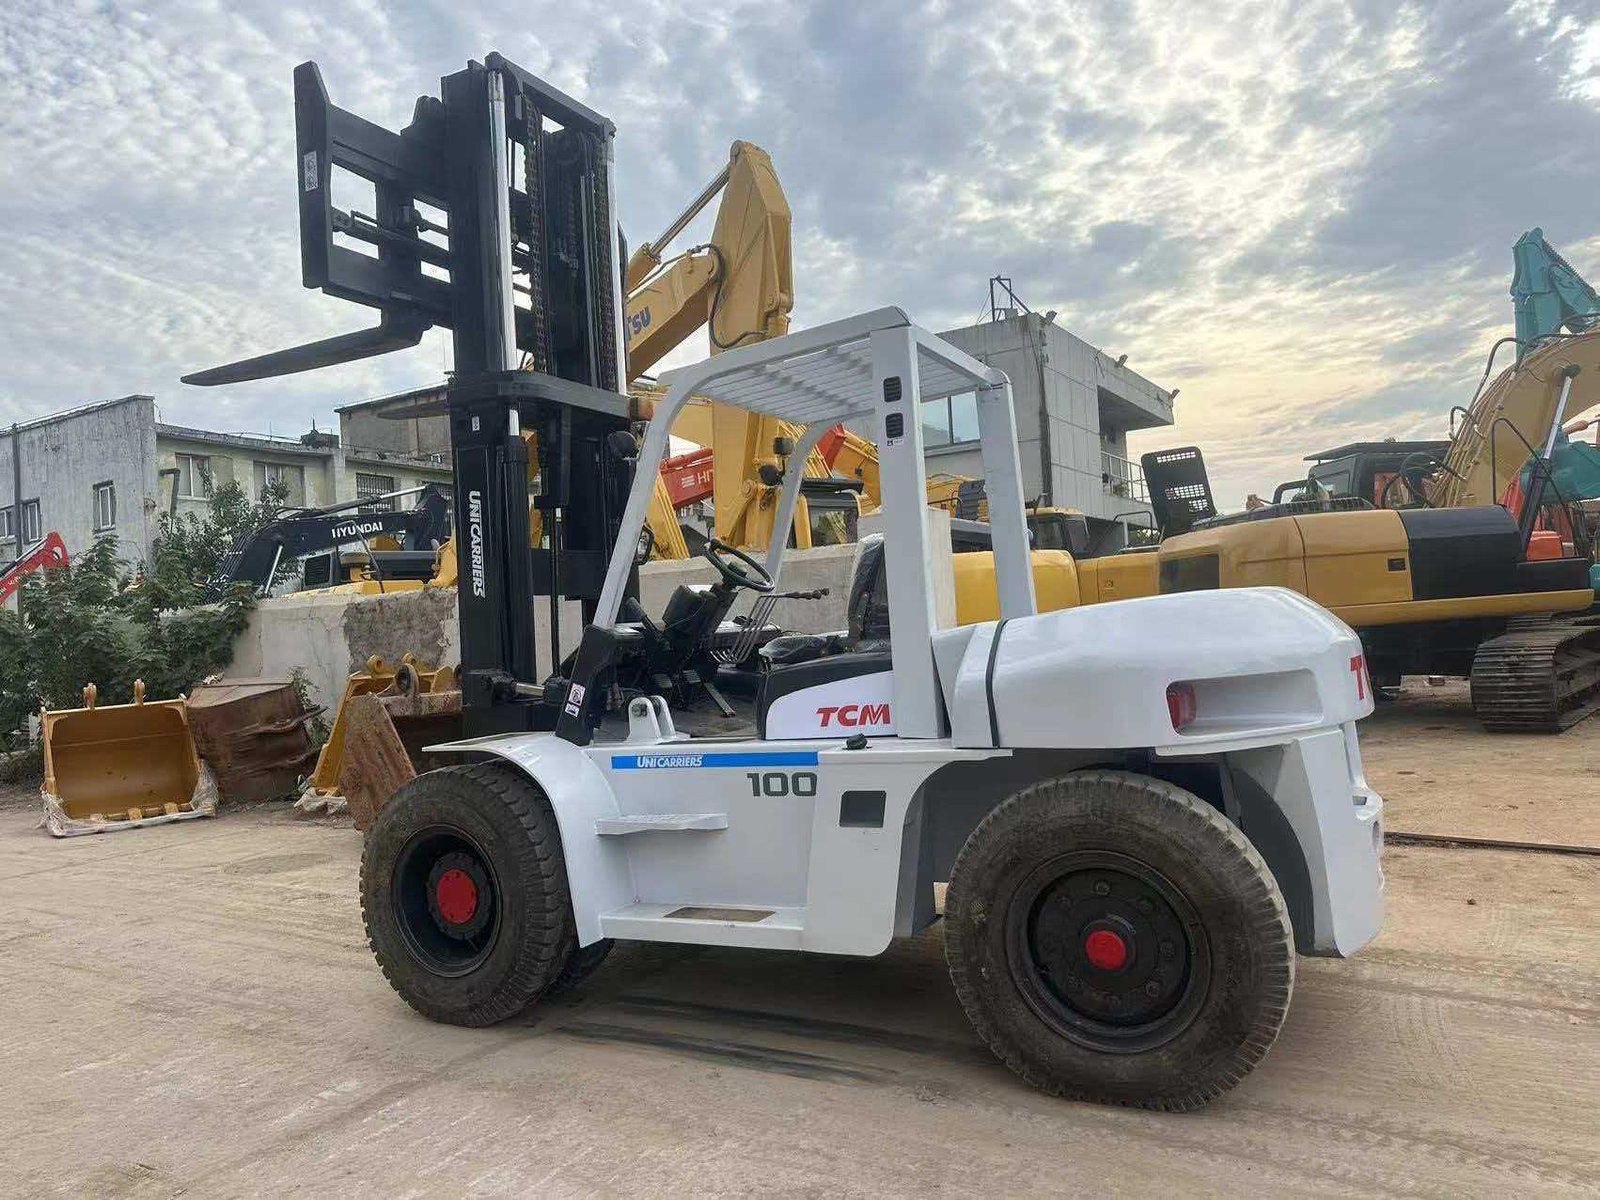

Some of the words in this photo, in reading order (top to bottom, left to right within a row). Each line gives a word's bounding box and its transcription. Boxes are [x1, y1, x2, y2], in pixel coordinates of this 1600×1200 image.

[331, 521, 383, 538] HYUNDAI
[469, 490, 485, 598] UNICARRIERS
[816, 703, 891, 727] TCM
[637, 756, 702, 768] UNICARRIERS
[746, 772, 818, 798] 100
